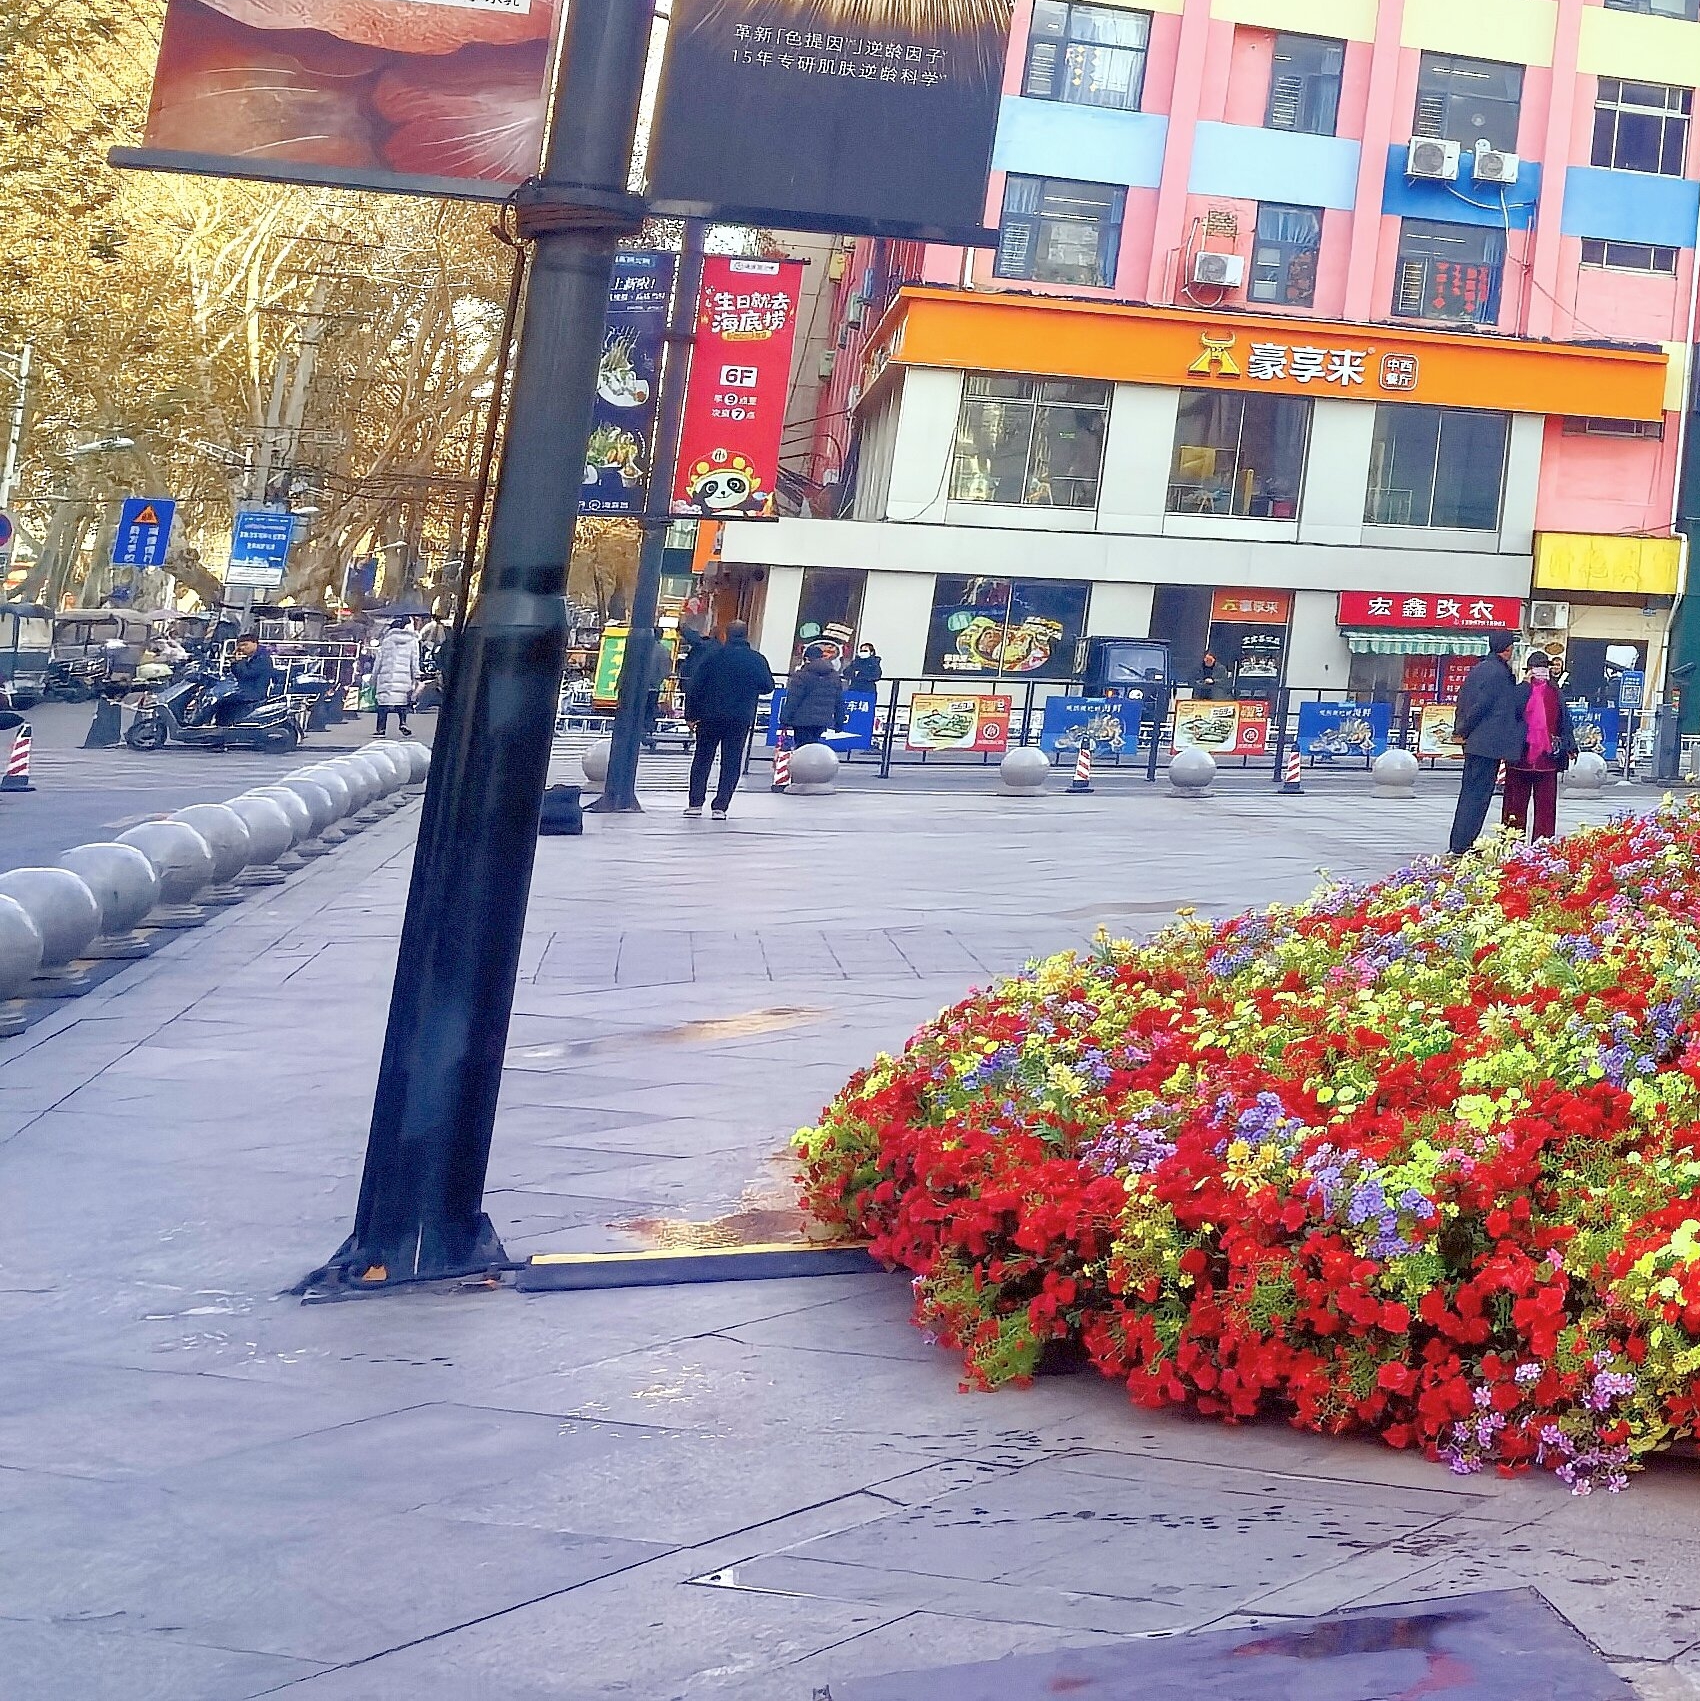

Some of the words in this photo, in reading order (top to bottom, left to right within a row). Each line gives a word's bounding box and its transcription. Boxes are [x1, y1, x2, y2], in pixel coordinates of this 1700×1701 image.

[713, 291, 791, 311] 生日就去
[711, 310, 786, 333] 海底捞
[1247, 342, 1367, 386] 豪享来
[1386, 359, 1414, 373] 中西
[725, 369, 752, 384] 6F
[1386, 372, 1412, 386] 餐厅
[1367, 596, 1495, 620] 宏鑫改衣
